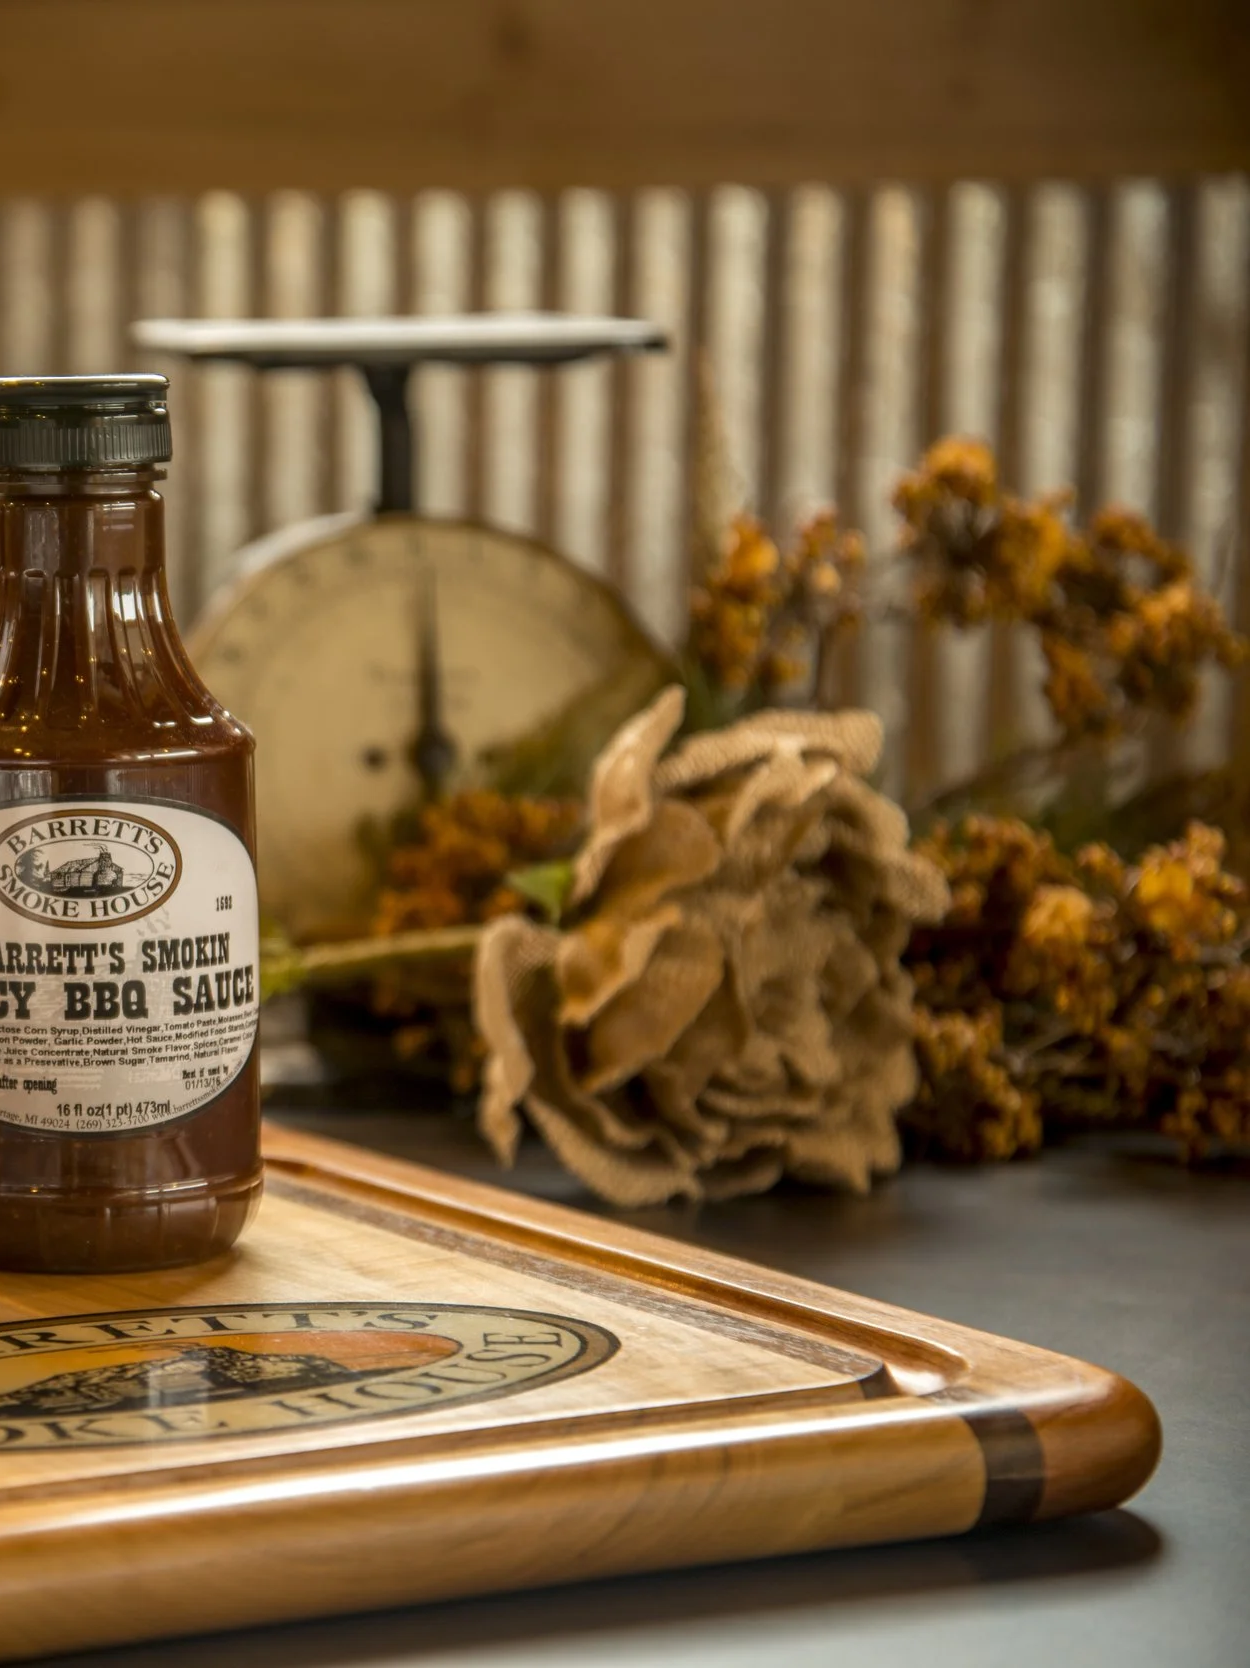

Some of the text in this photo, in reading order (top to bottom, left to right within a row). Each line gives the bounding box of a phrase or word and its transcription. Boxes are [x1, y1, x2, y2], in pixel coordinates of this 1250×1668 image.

[6, 818, 164, 856] BARRETT'S
[90, 862, 175, 918] HOUSE
[141, 931, 230, 973] SMOKIN
[64, 980, 148, 1021] BBQ
[172, 965, 254, 1016] SAUCE
[24, 1026, 47, 1034] Corn
[54, 1036, 83, 1046] Garlic
[210, 1027, 227, 1036] Food
[4, 1045, 162, 1056] Juice Smoke
[194, 1049, 219, 1059] Natural
[182, 1068, 196, 1079] Best
[199, 1066, 205, 1077] if
[23, 1077, 57, 1094] opening
[56, 1103, 70, 1116] 16
[74, 1103, 82, 1116] fl
[116, 1102, 133, 1119] pt)
[135, 1100, 171, 1116] 473ml
[25, 1113, 38, 1124] MI
[40, 1117, 70, 1129] 49024
[76, 1119, 102, 1130] (269)
[272, 1331, 563, 1418] HOUSE
